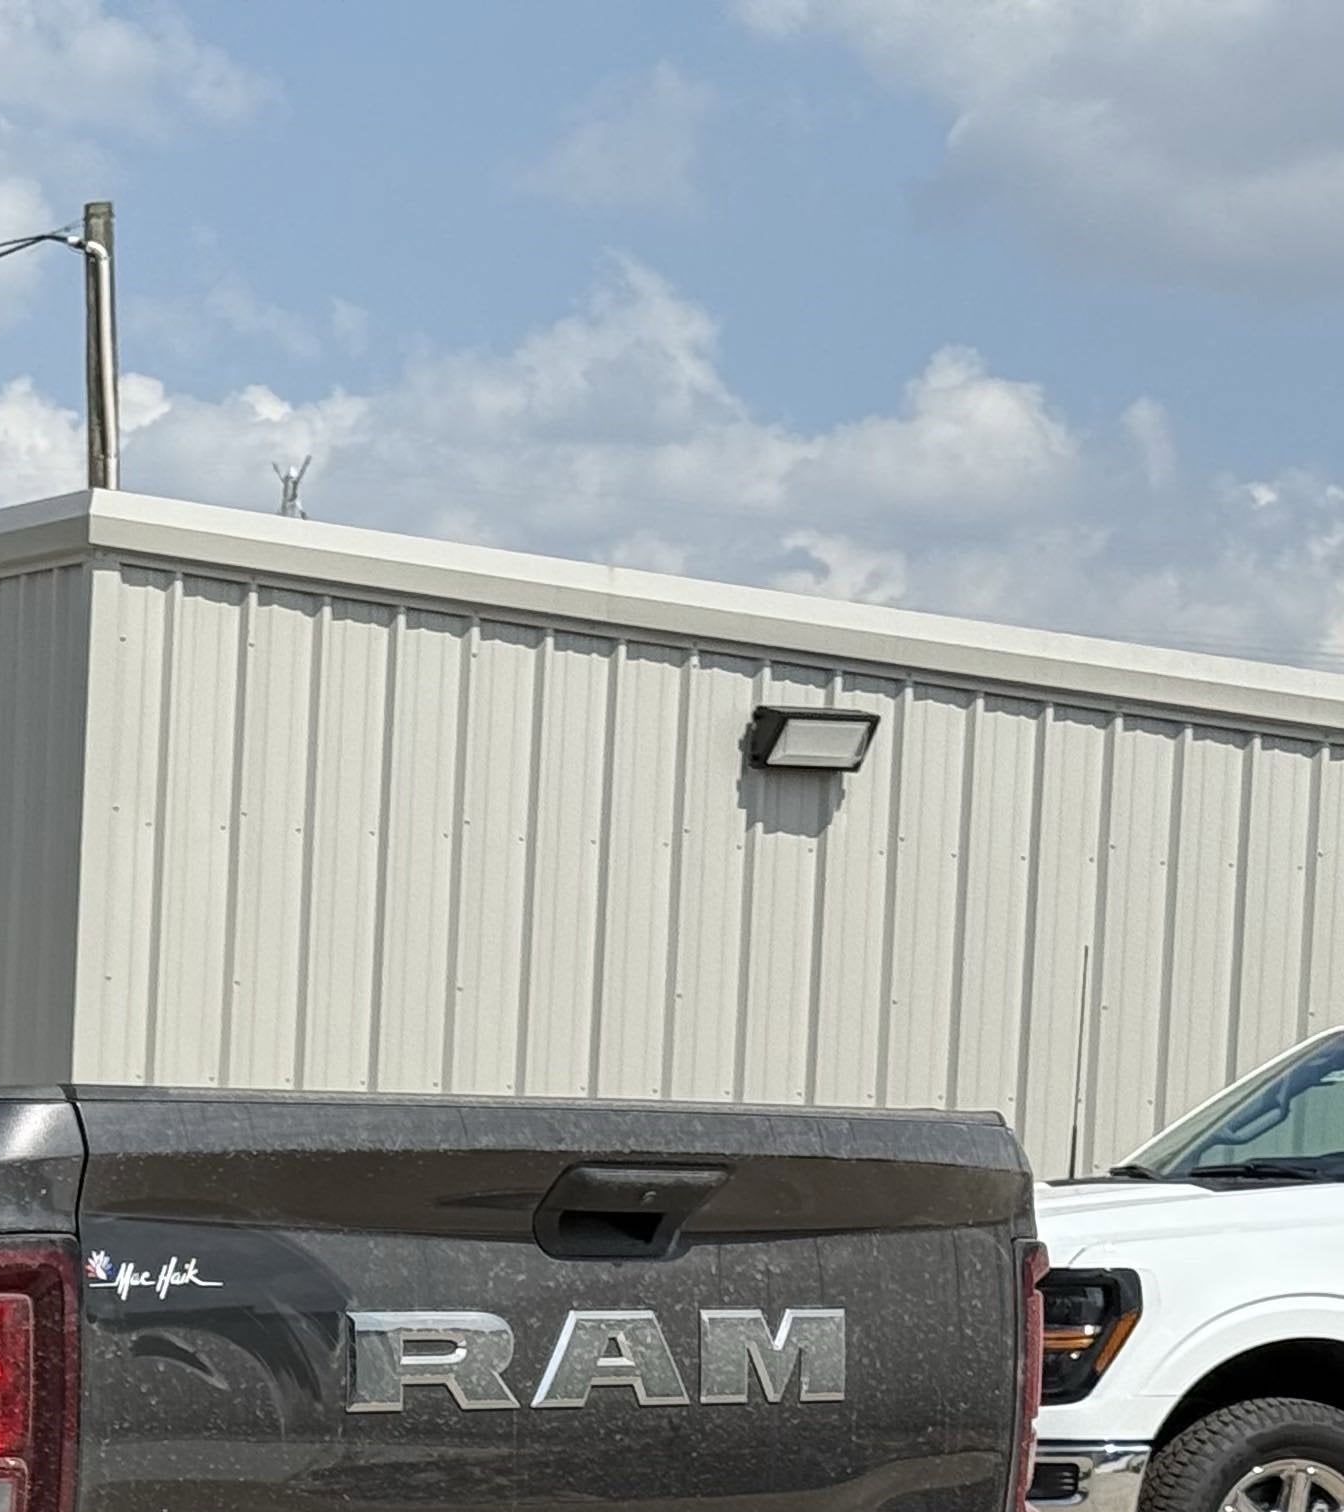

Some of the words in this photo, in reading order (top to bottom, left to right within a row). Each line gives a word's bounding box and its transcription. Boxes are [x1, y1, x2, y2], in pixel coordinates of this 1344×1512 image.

[89, 1261, 156, 1301] Mac
[155, 1256, 224, 1300] Haik
[346, 1308, 847, 1413] RAM
